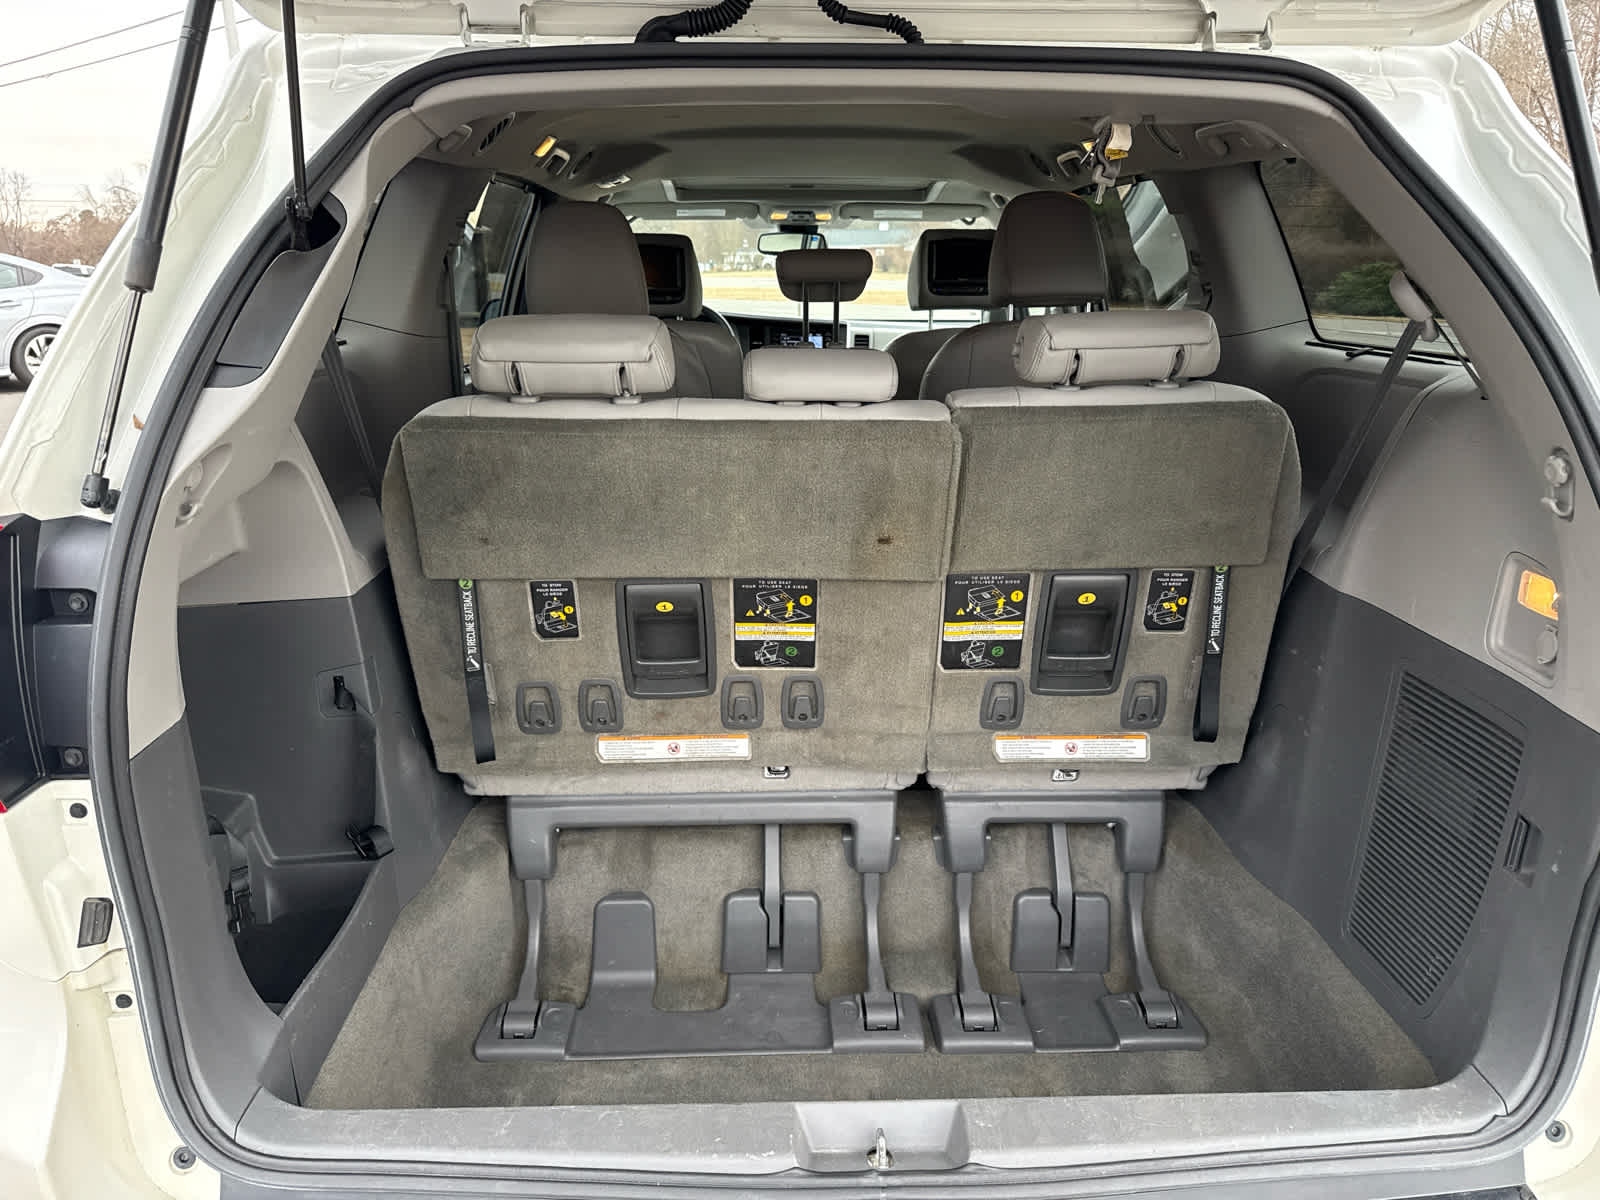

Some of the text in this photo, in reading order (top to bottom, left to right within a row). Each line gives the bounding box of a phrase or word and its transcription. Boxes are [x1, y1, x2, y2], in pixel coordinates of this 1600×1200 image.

[462, 590, 477, 654] TO RECLINE SEATBACK
[1210, 574, 1225, 637] TO RECLINE SEATBACK
